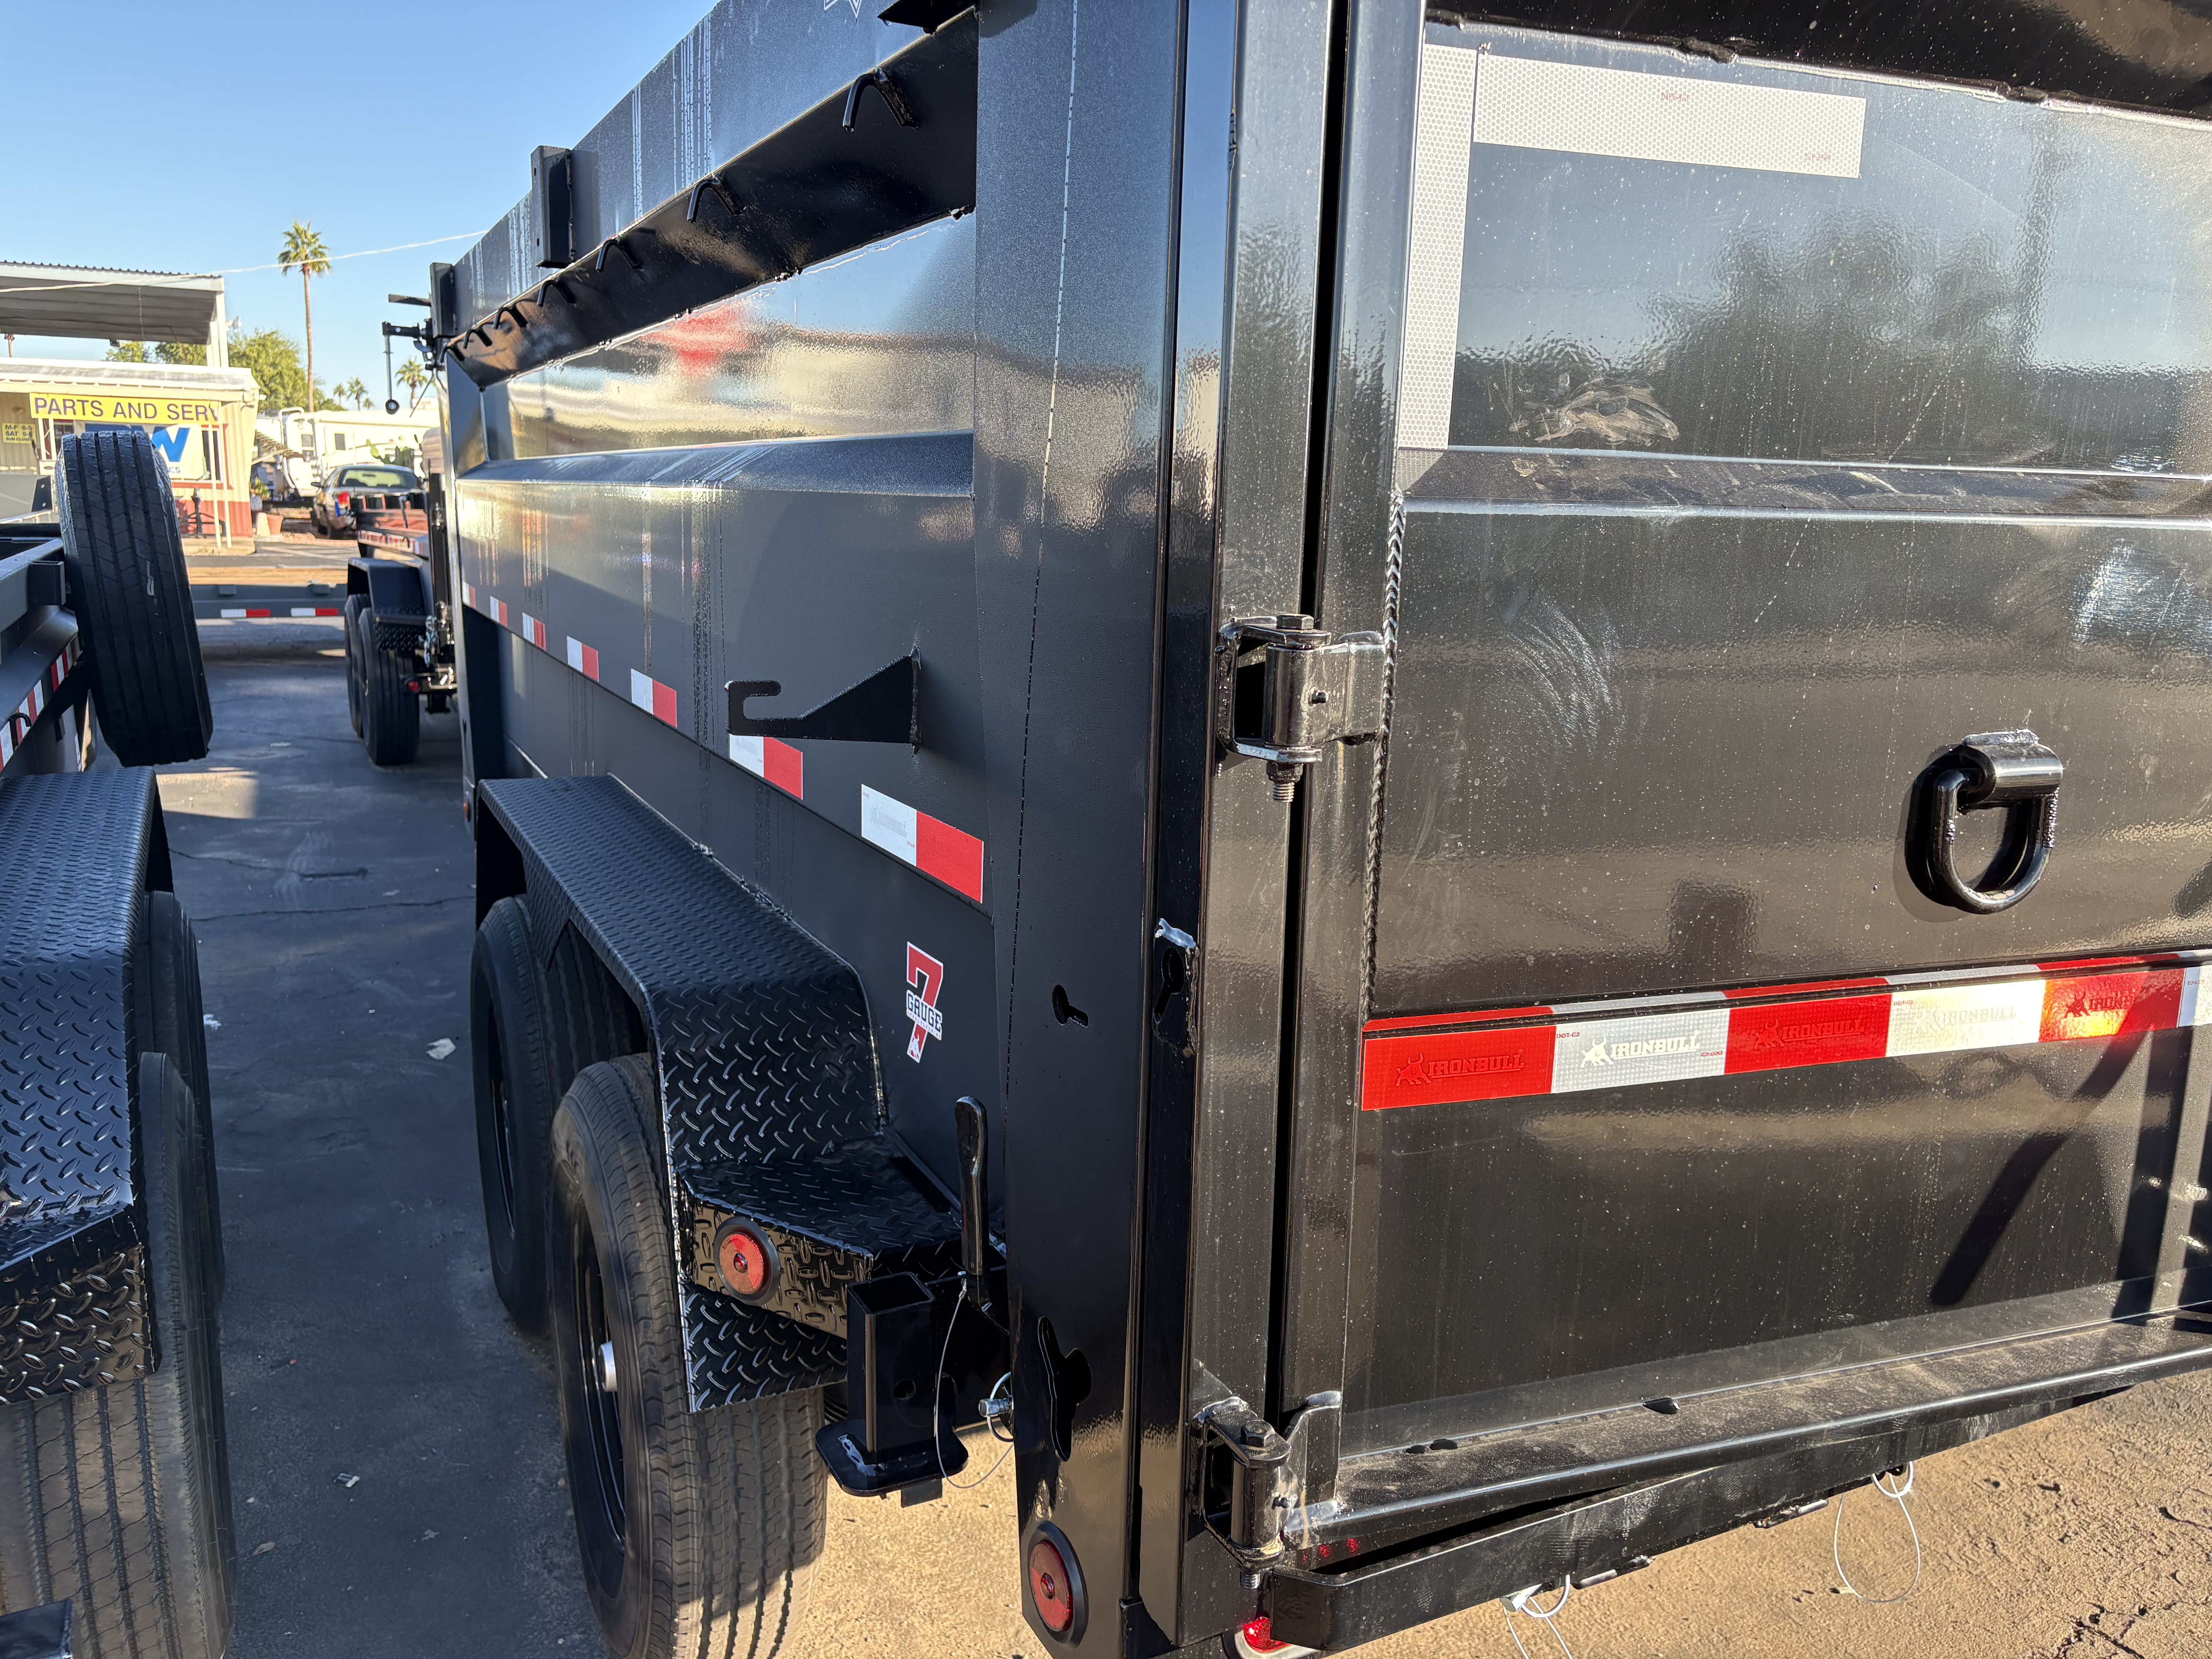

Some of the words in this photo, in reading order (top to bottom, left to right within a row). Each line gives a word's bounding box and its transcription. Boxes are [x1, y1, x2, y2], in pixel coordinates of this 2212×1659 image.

[34, 397, 104, 417] PARTS
[113, 402, 158, 419] AND
[908, 993, 941, 1033] GAUGE
[1942, 1006, 2016, 1025] IRONBULL
[1782, 1020, 1864, 1040] IRONBULL
[1610, 1036, 1700, 1058] IRONBULL
[1427, 1054, 1525, 1076] IRONBULL
